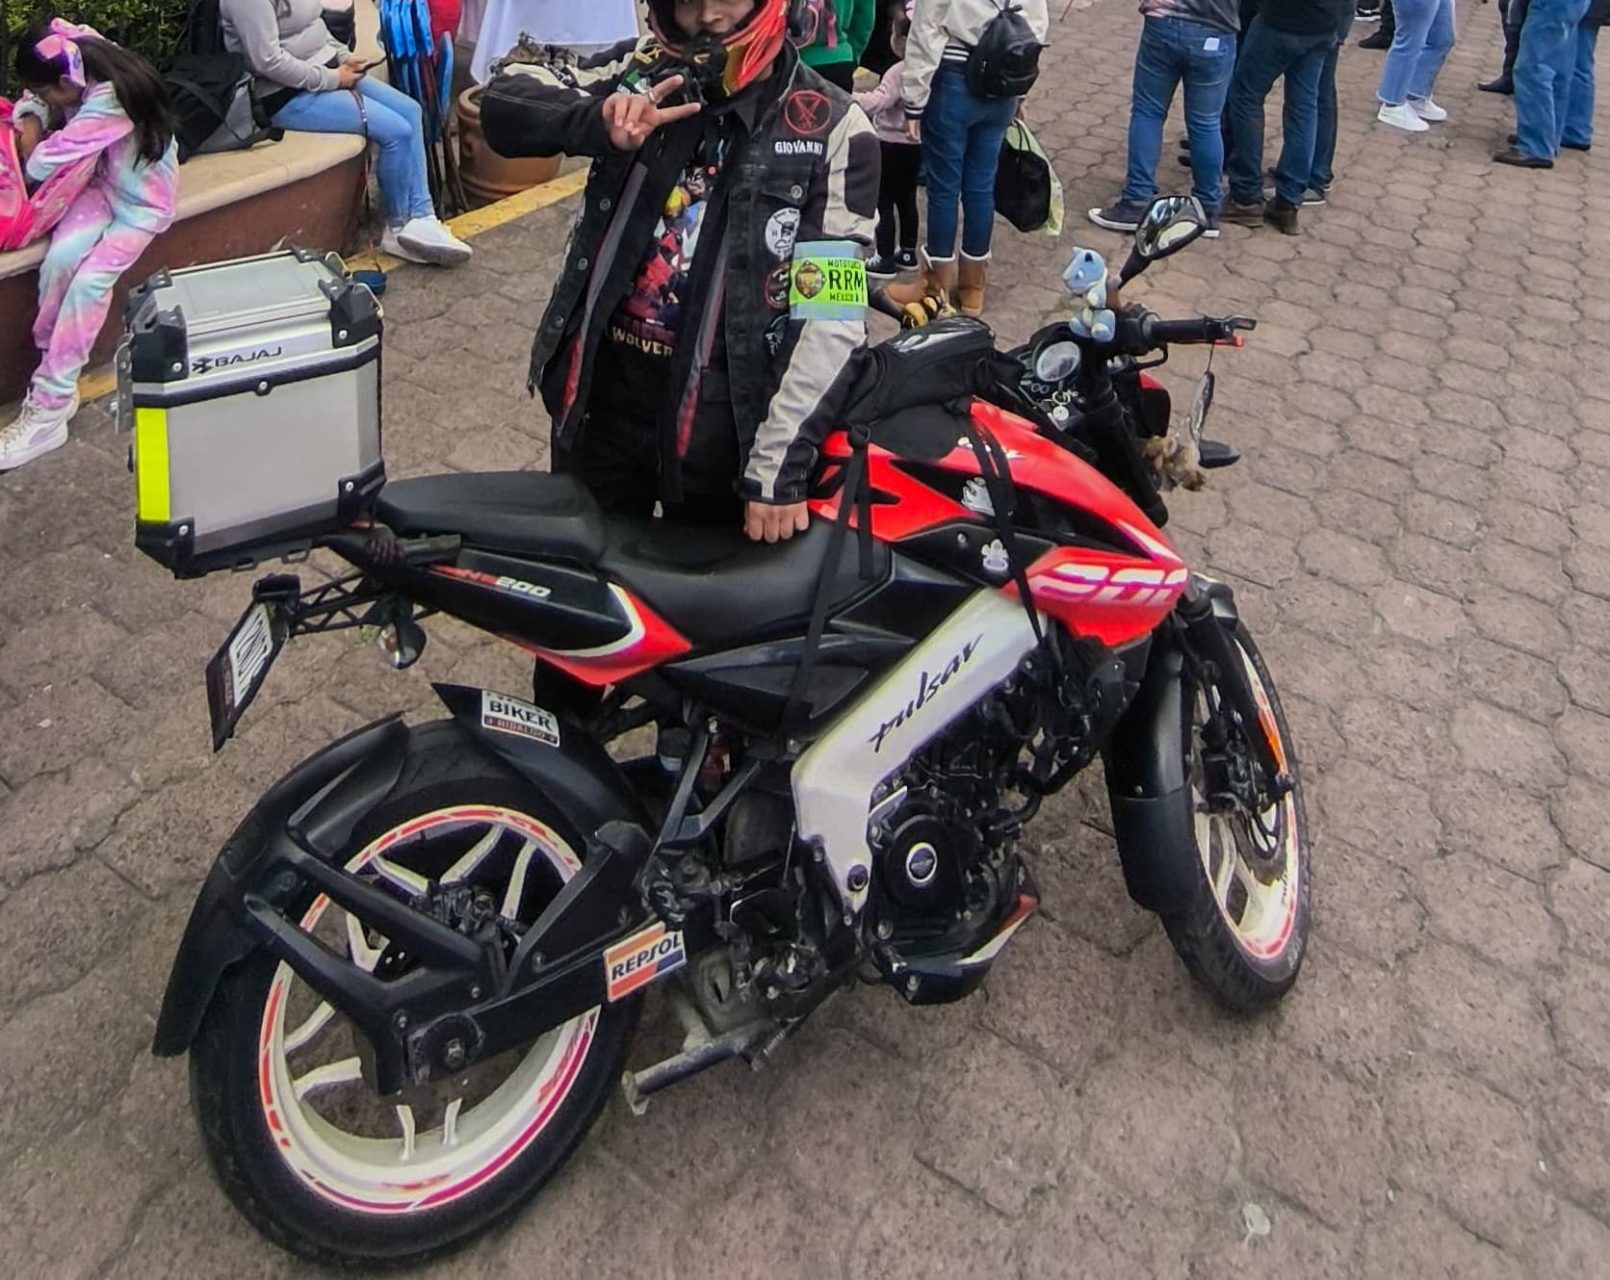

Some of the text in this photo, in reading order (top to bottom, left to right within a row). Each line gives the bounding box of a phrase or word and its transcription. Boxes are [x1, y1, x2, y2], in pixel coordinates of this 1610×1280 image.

[774, 139, 824, 156] GIOVANNI
[828, 269, 864, 291] RRM
[214, 345, 283, 368] BAJAJ
[489, 700, 553, 732] BIKER
[611, 933, 681, 981] REPSOL
